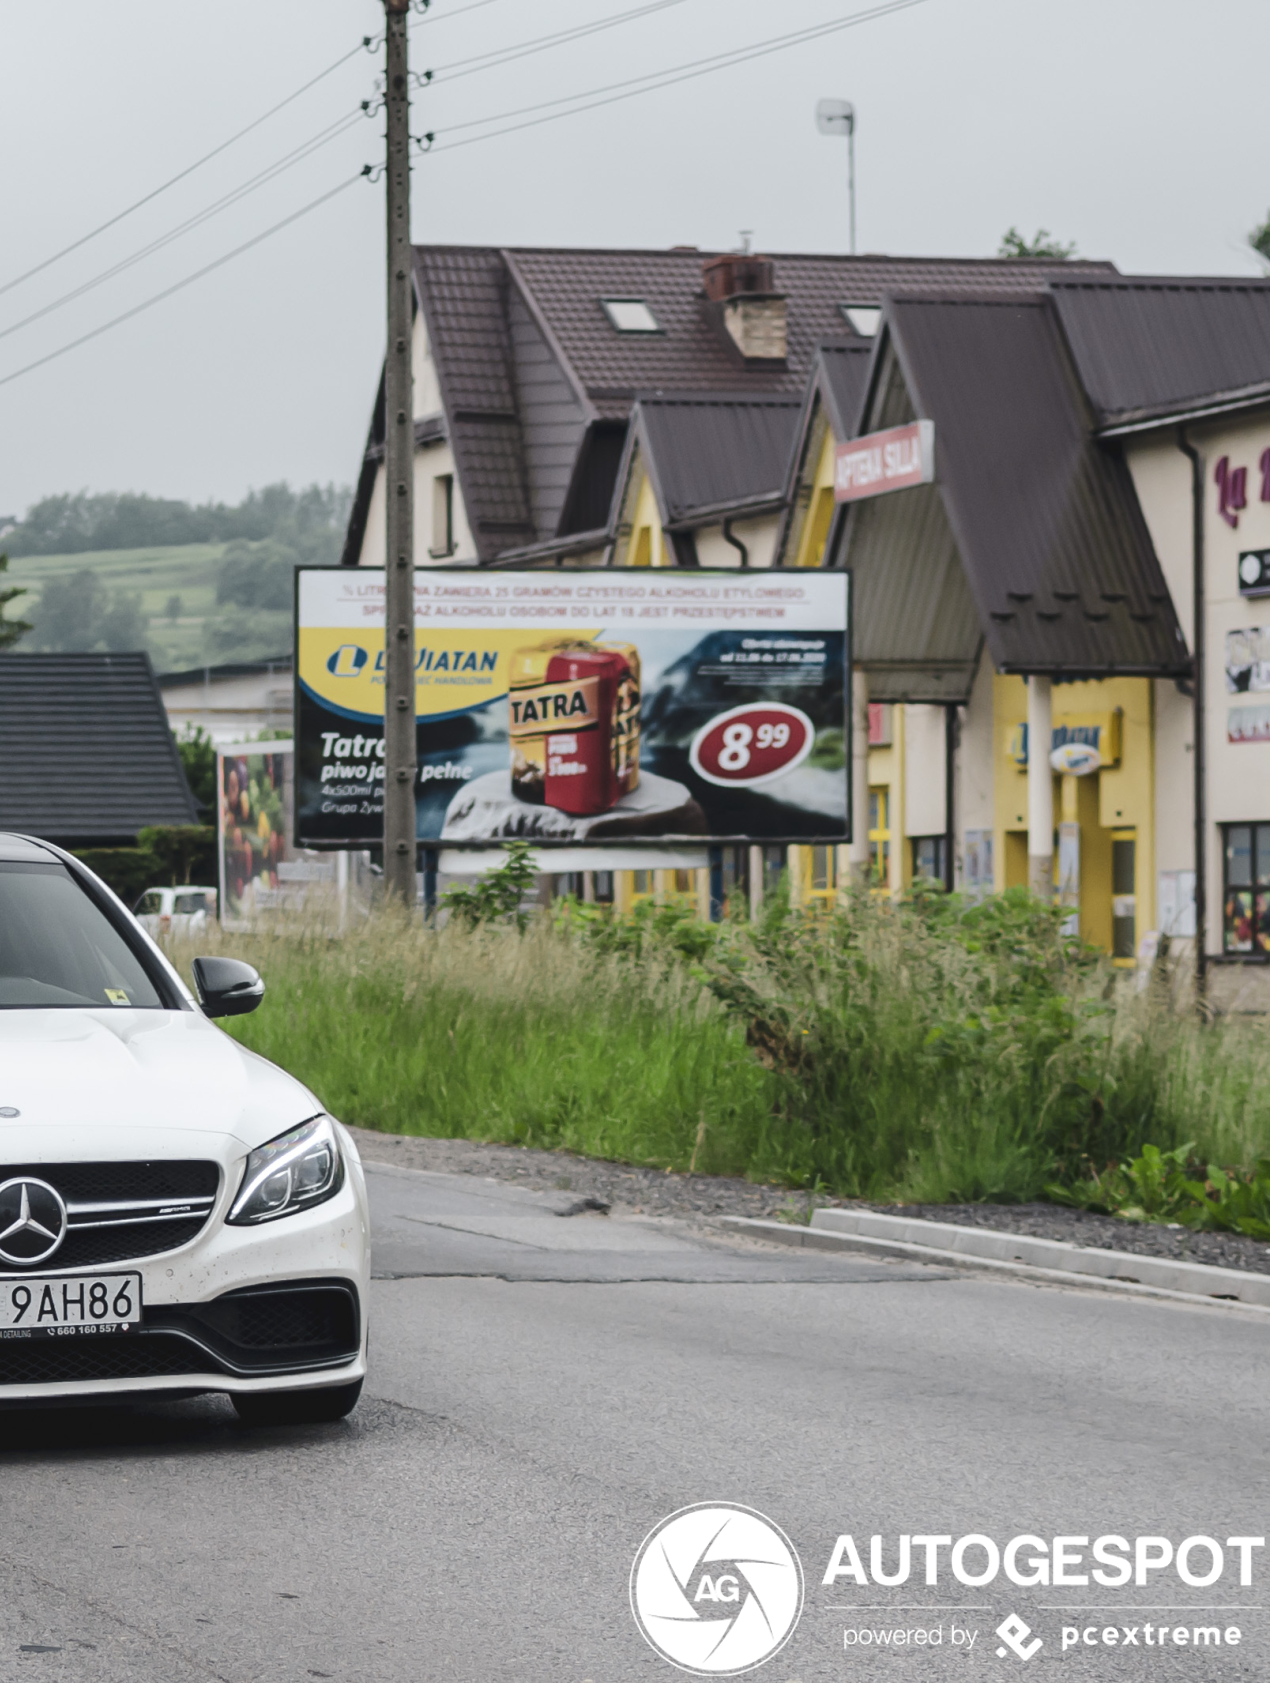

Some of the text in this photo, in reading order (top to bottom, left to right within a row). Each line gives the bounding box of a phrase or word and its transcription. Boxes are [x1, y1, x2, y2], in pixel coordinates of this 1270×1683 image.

[884, 437, 920, 478] SILLA
[494, 586, 509, 598] 25
[576, 587, 645, 599] CZYSTEGO
[649, 587, 720, 599] ALKOHOLU
[435, 605, 507, 617] ALKOHOLU
[510, 605, 568, 617] OSOBOM
[571, 606, 591, 618] DO
[593, 606, 617, 618] LAT
[637, 606, 669, 618] JEST
[511, 690, 588, 724] TATRA
[320, 761, 367, 782] piwo
[420, 761, 474, 782] pełne
[321, 801, 357, 814] Grupa
[11, 1280, 132, 1323] 9AH86
[3, 1329, 32, 1339] DETAILING
[57, 1326, 76, 1336] 660
[78, 1325, 97, 1334] 160
[99, 1323, 118, 1333] 557
